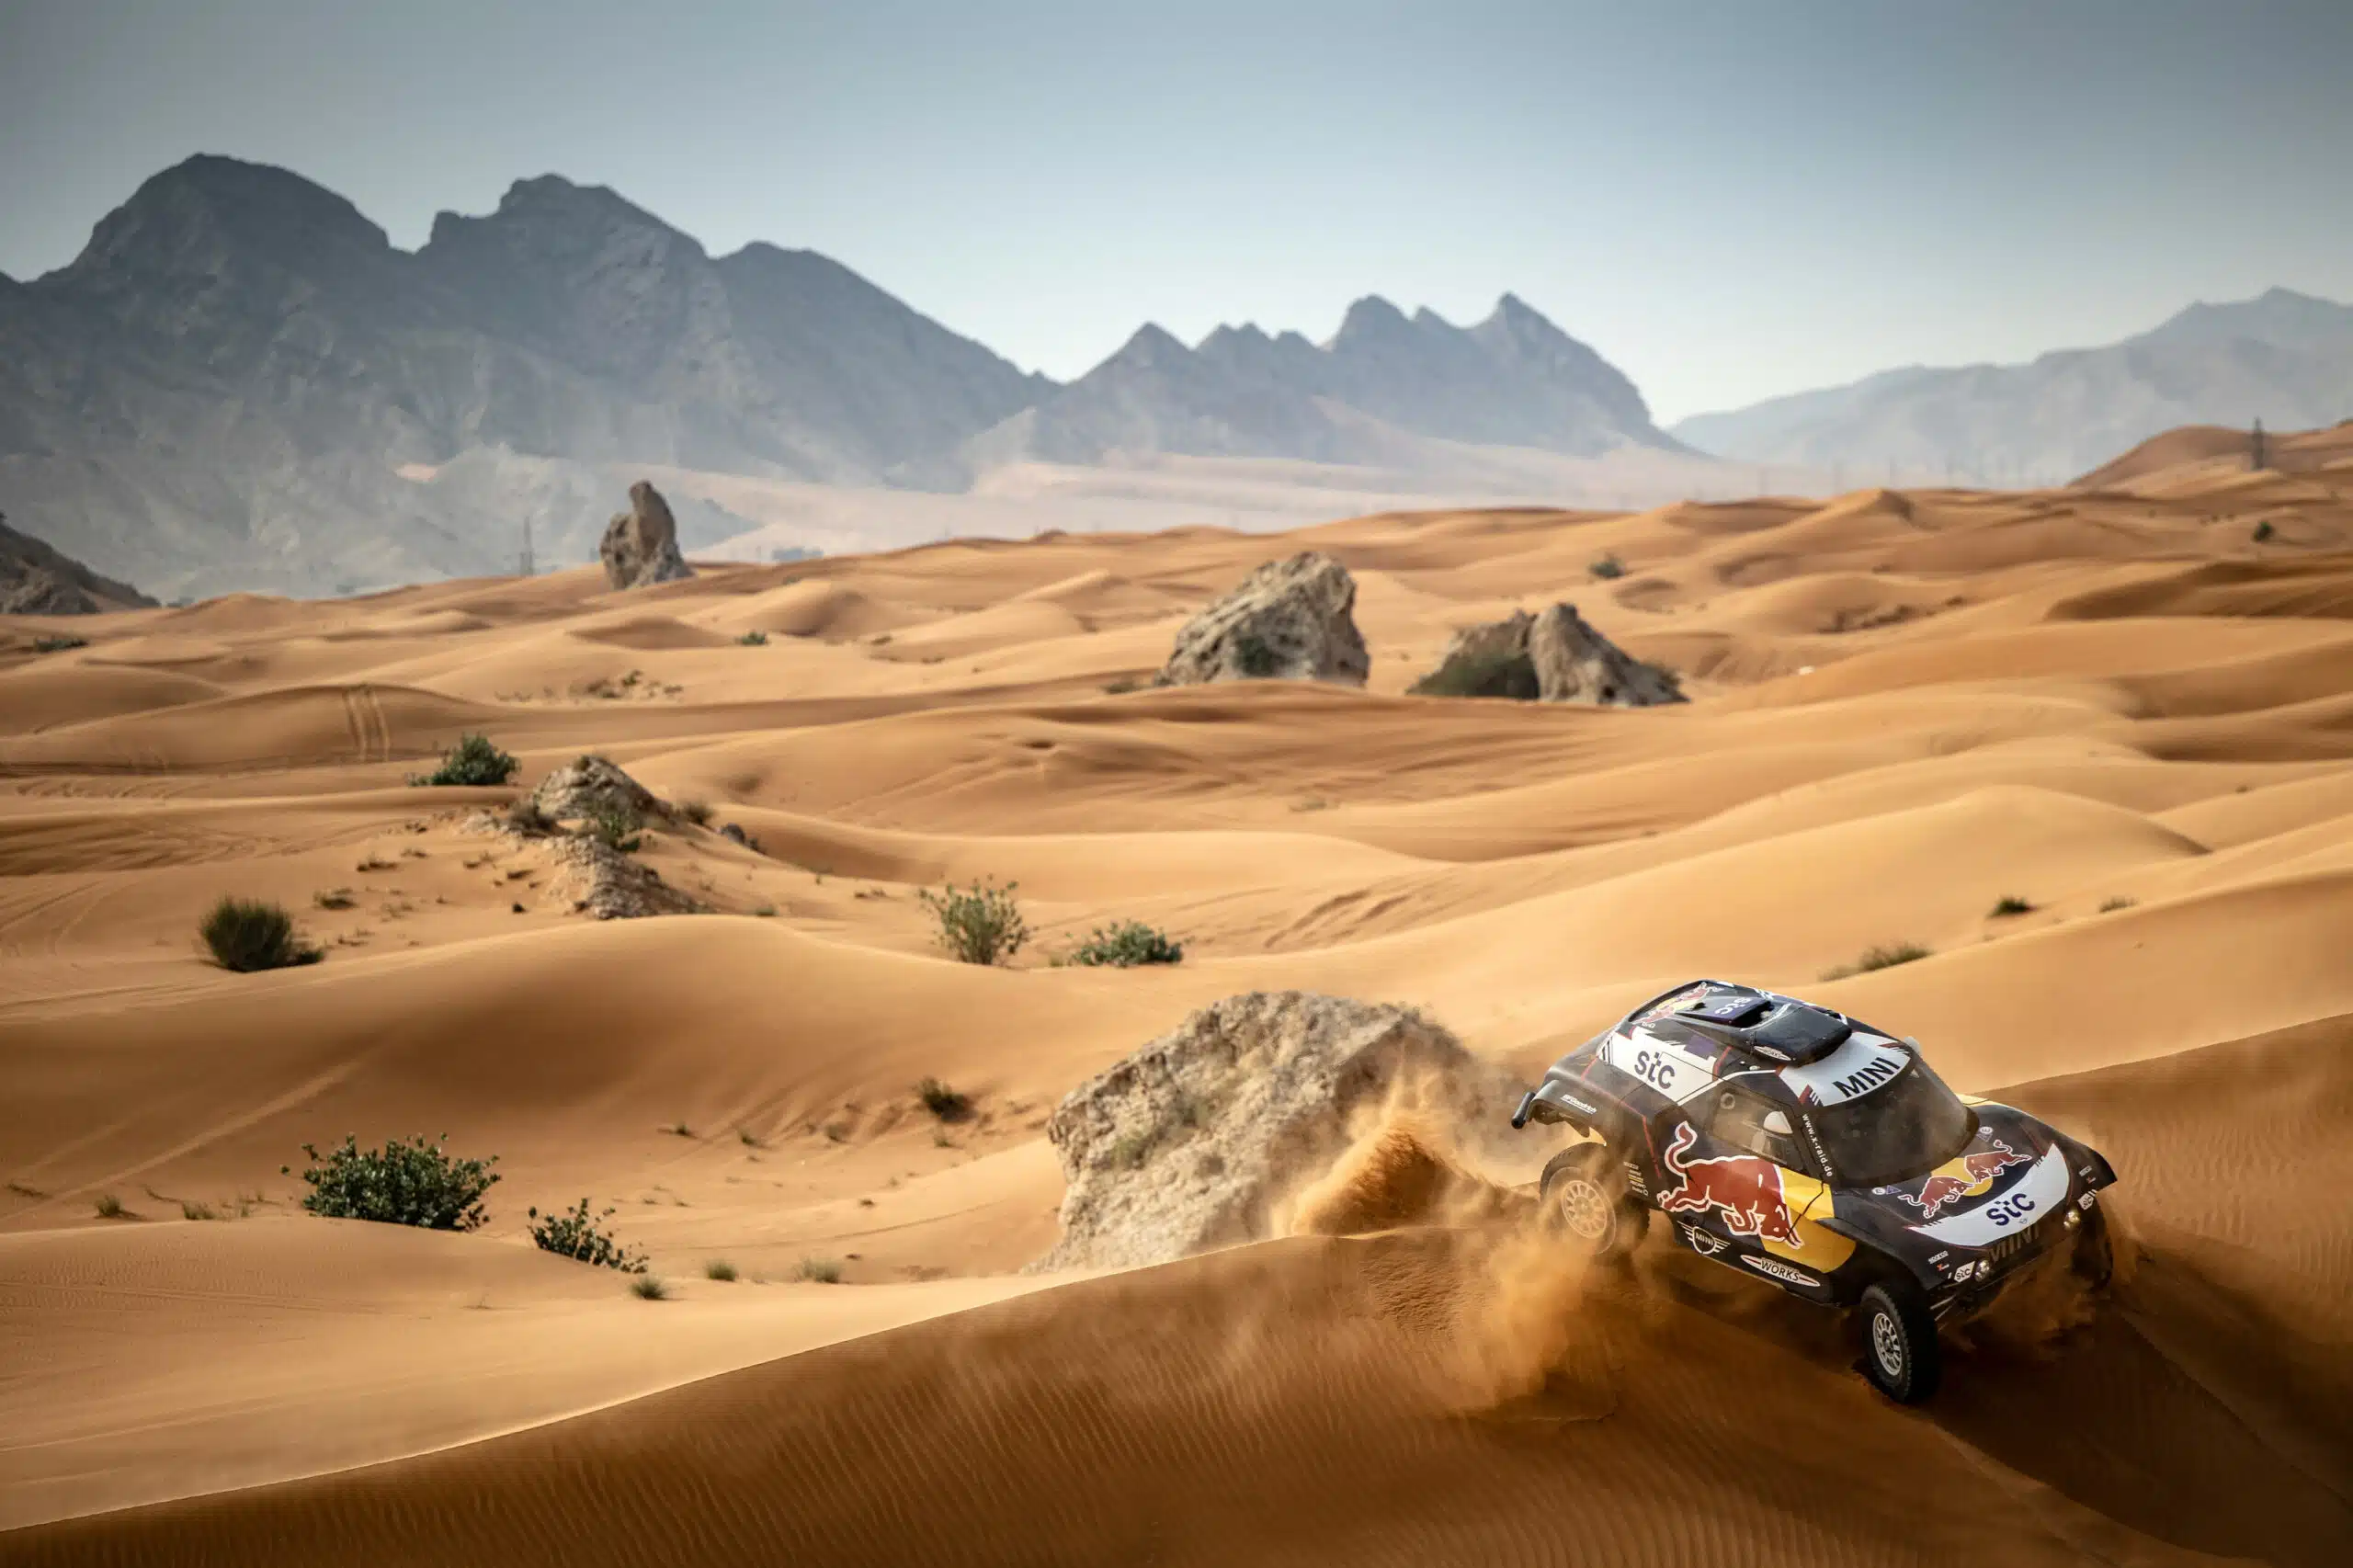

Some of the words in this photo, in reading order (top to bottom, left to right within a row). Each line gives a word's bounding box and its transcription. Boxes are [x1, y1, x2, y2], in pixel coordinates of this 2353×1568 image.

[1634, 1051, 1676, 1090] stc
[1832, 1057, 1901, 1098] MINI
[1802, 1113, 1833, 1177] www.x-raid.de
[1985, 1193, 2035, 1226] stc
[1761, 1260, 1800, 1281] WORKS
